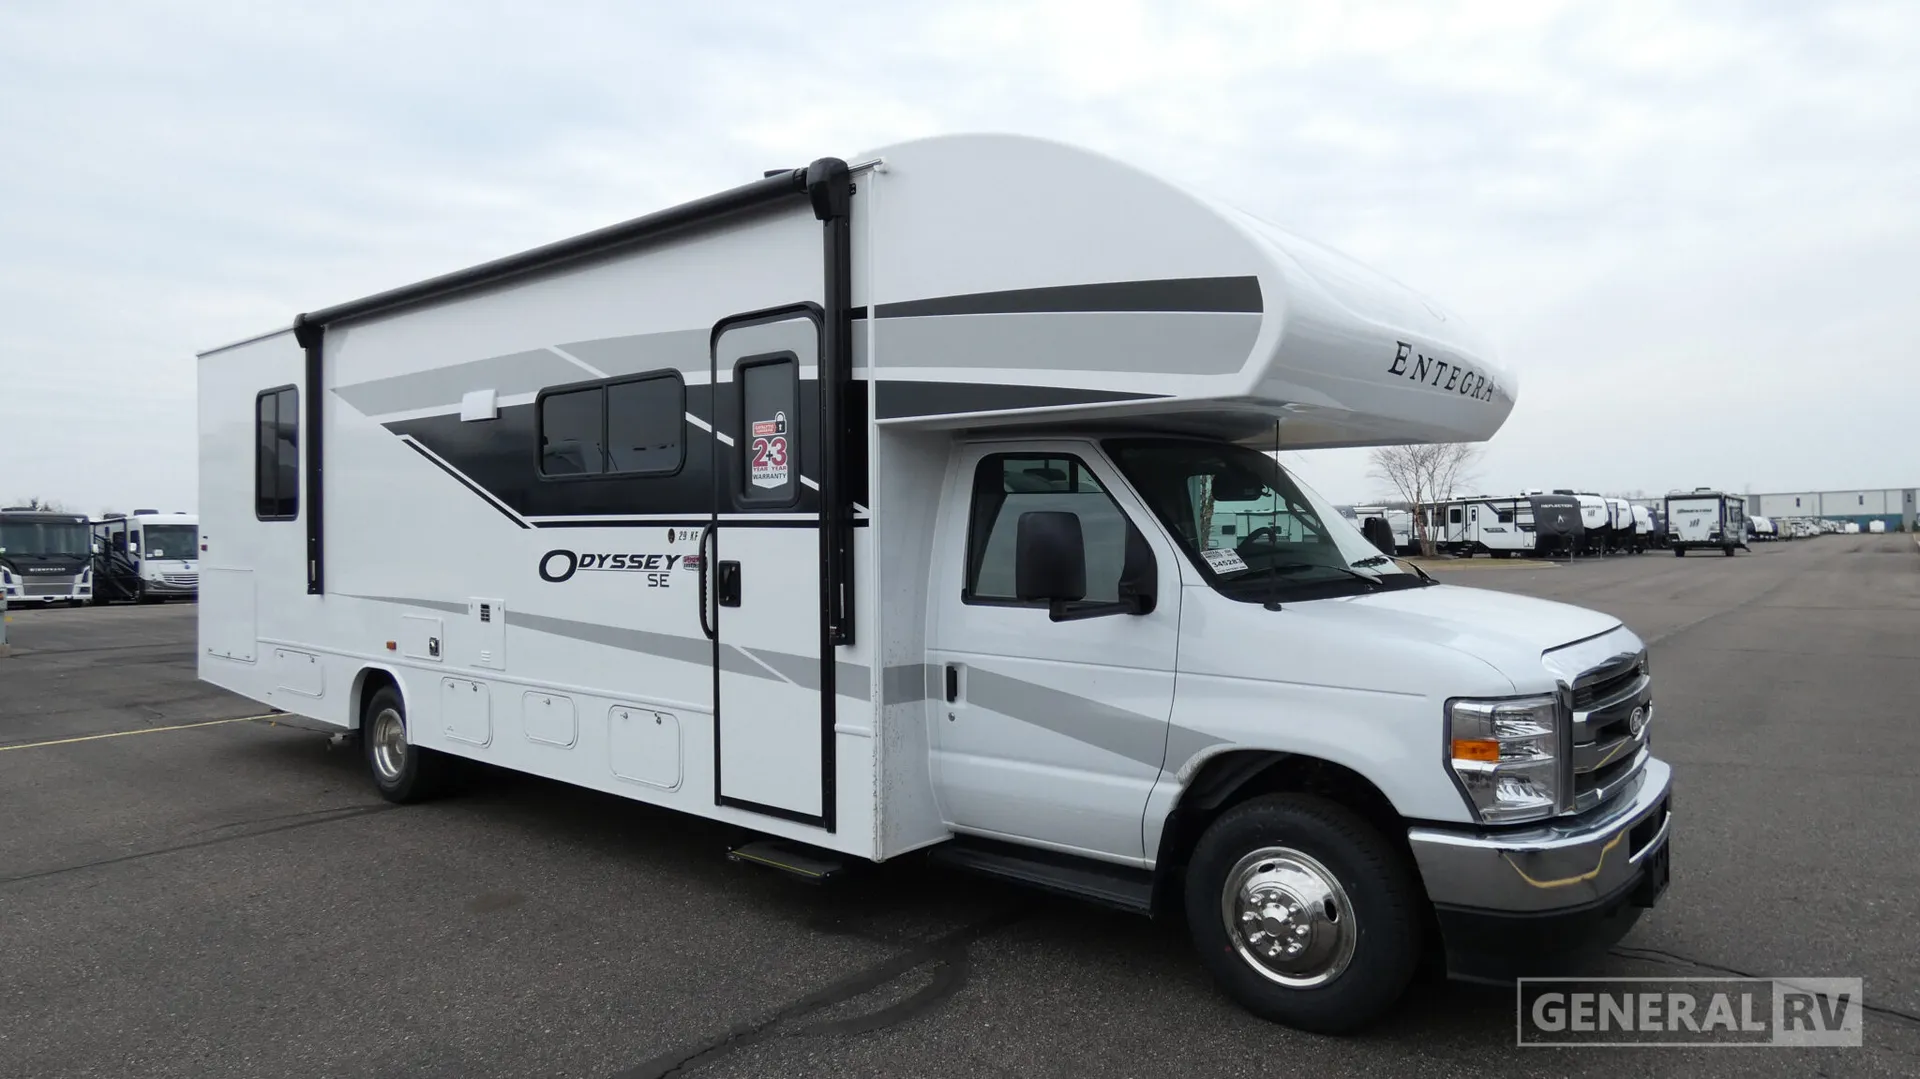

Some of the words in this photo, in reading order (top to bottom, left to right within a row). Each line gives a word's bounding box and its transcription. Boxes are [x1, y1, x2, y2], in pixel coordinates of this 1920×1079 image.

[1387, 340, 1495, 402] ENTEGRA
[538, 549, 682, 583] ODYSSEY
[647, 573, 670, 588] SE
